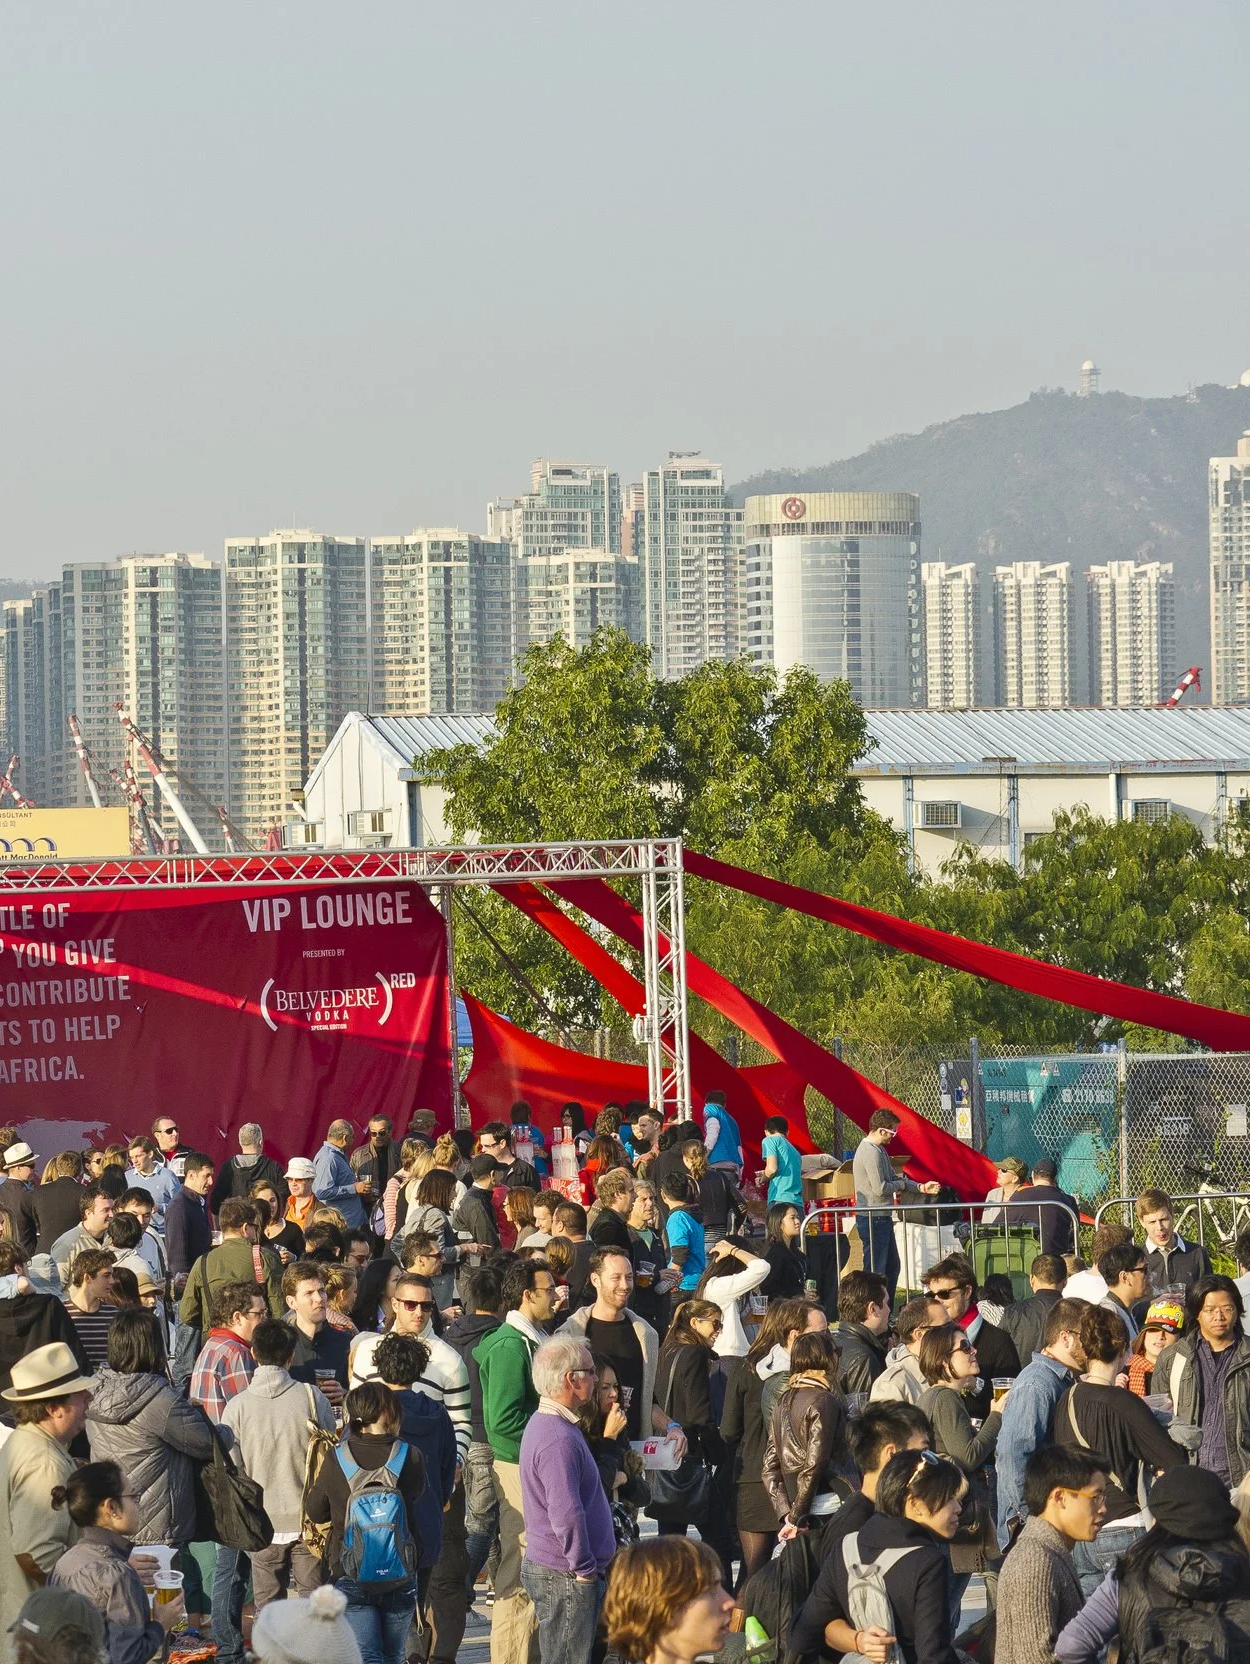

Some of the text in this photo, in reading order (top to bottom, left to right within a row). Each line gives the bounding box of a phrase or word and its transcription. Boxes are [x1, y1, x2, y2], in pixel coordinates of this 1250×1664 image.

[43, 903, 70, 929] OF
[242, 890, 413, 933] VIP LOUNGE
[11, 942, 56, 968] YOU
[65, 938, 117, 966] GIVE
[302, 948, 345, 958] PRESENTED BY
[390, 972, 416, 989] RED
[28, 1018, 56, 1044] TO
[64, 1014, 121, 1041] HELP
[306, 1010, 349, 1022] VODKA
